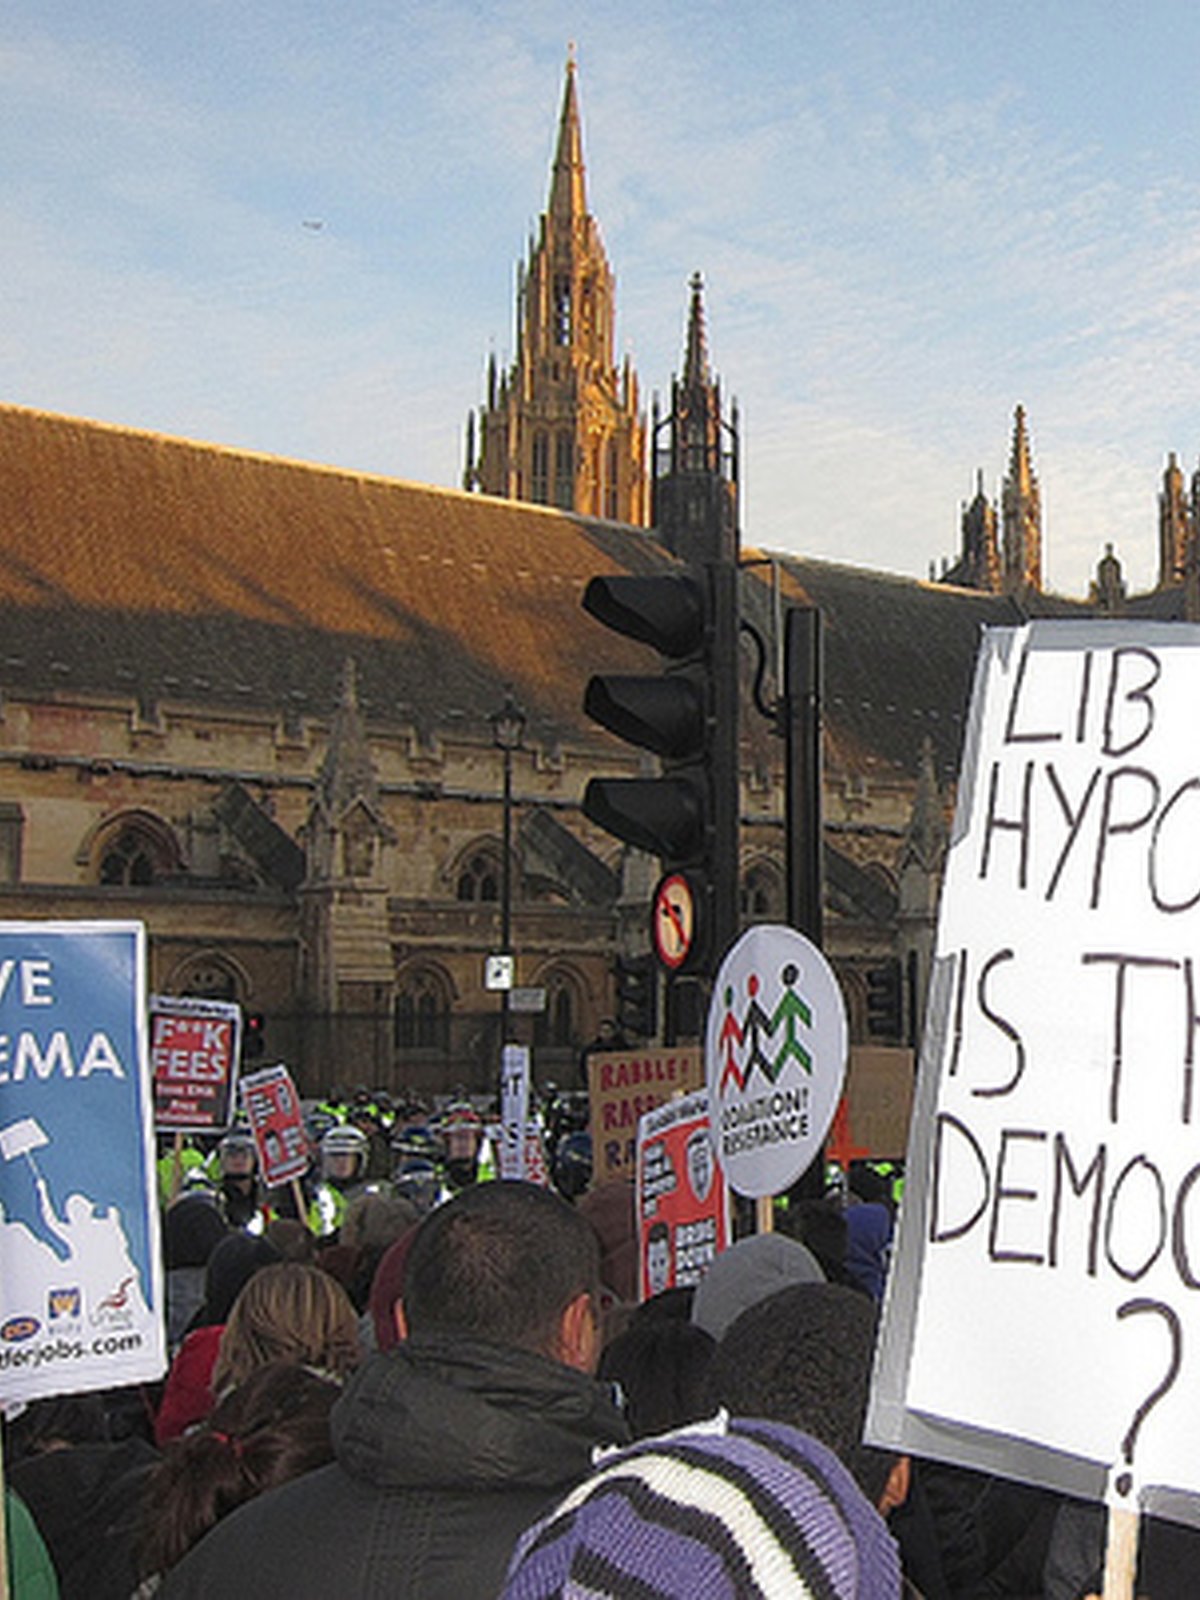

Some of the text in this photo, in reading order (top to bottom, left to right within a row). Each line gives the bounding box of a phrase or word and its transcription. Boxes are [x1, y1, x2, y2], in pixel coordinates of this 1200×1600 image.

[1004, 647, 1161, 756] LIB
[153, 1048, 227, 1080] FEES
[601, 1057, 689, 1092] RABBLE!
[948, 949, 1025, 1098] IS
[1115, 1298, 1182, 1498] ?
